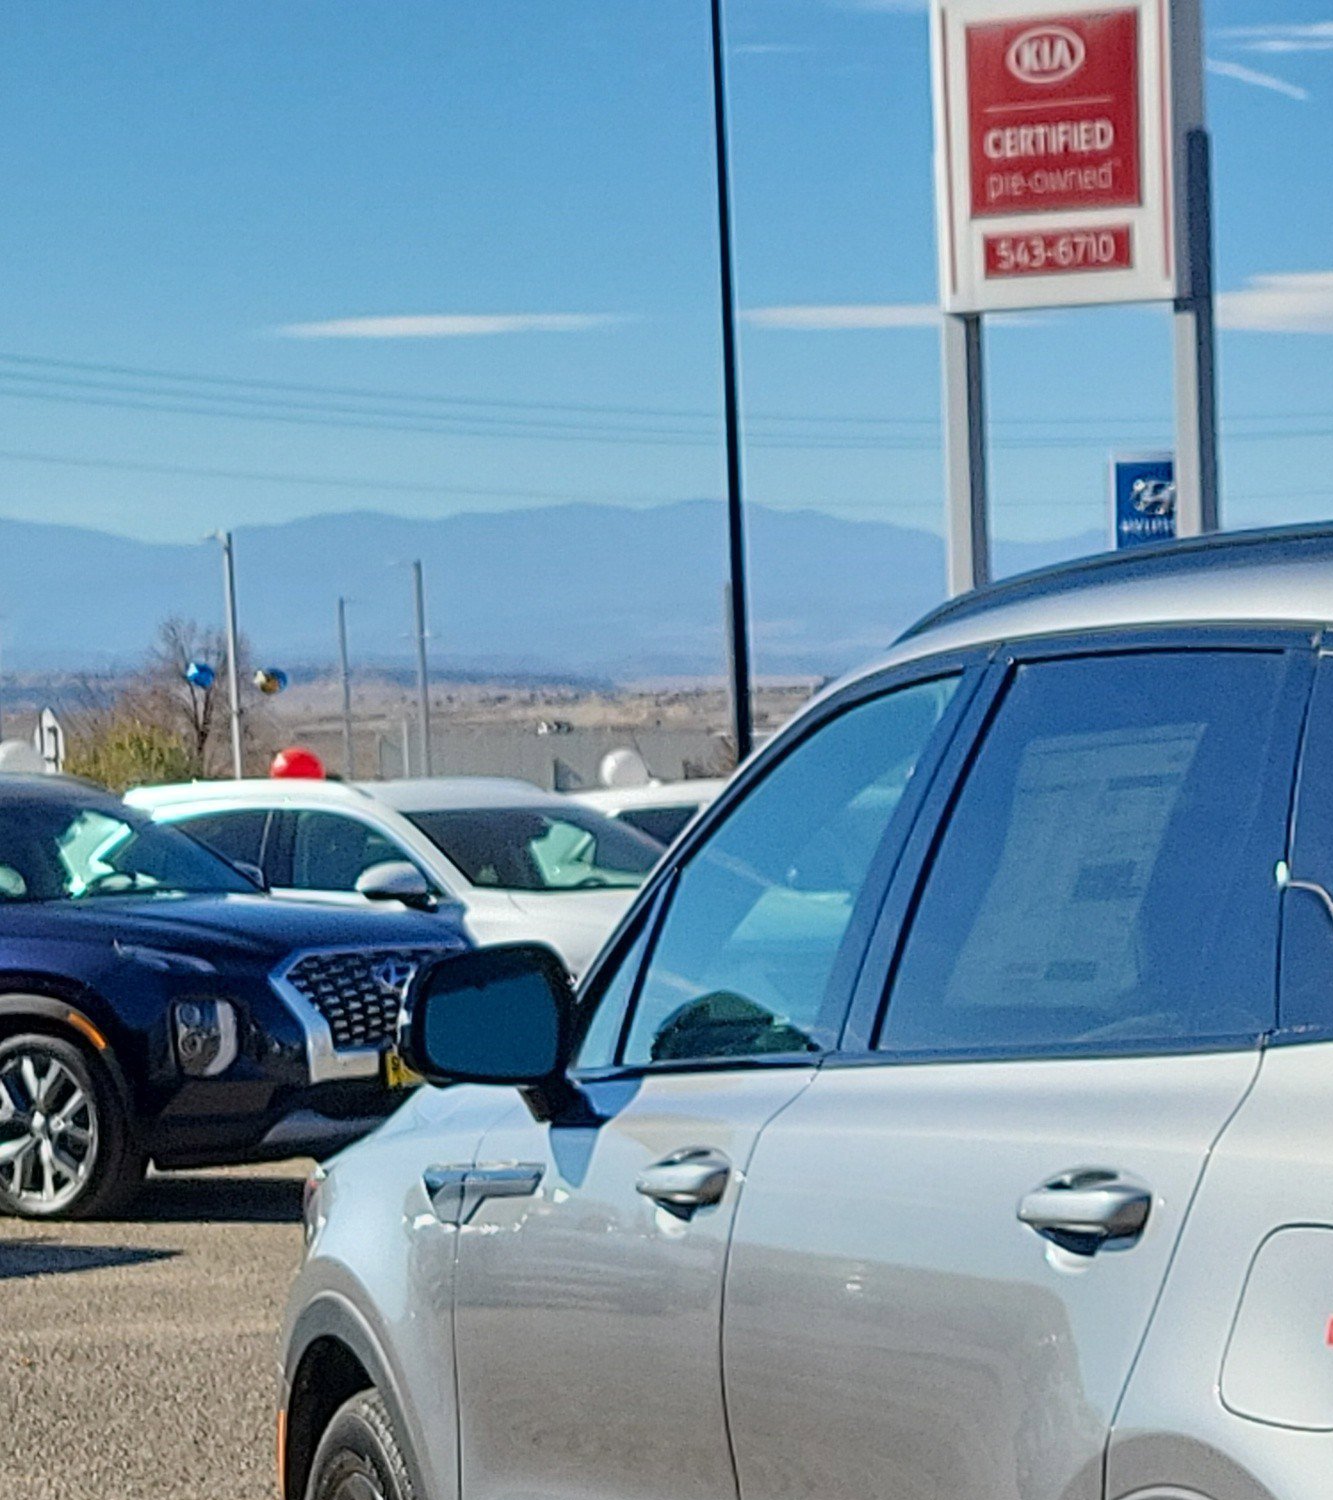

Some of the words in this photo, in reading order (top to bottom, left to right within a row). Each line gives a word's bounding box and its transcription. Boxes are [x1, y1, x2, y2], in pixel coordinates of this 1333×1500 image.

[1018, 36, 1074, 72] KIA
[983, 118, 1115, 160] CERTIFIED
[997, 232, 1116, 271] 543-6710
